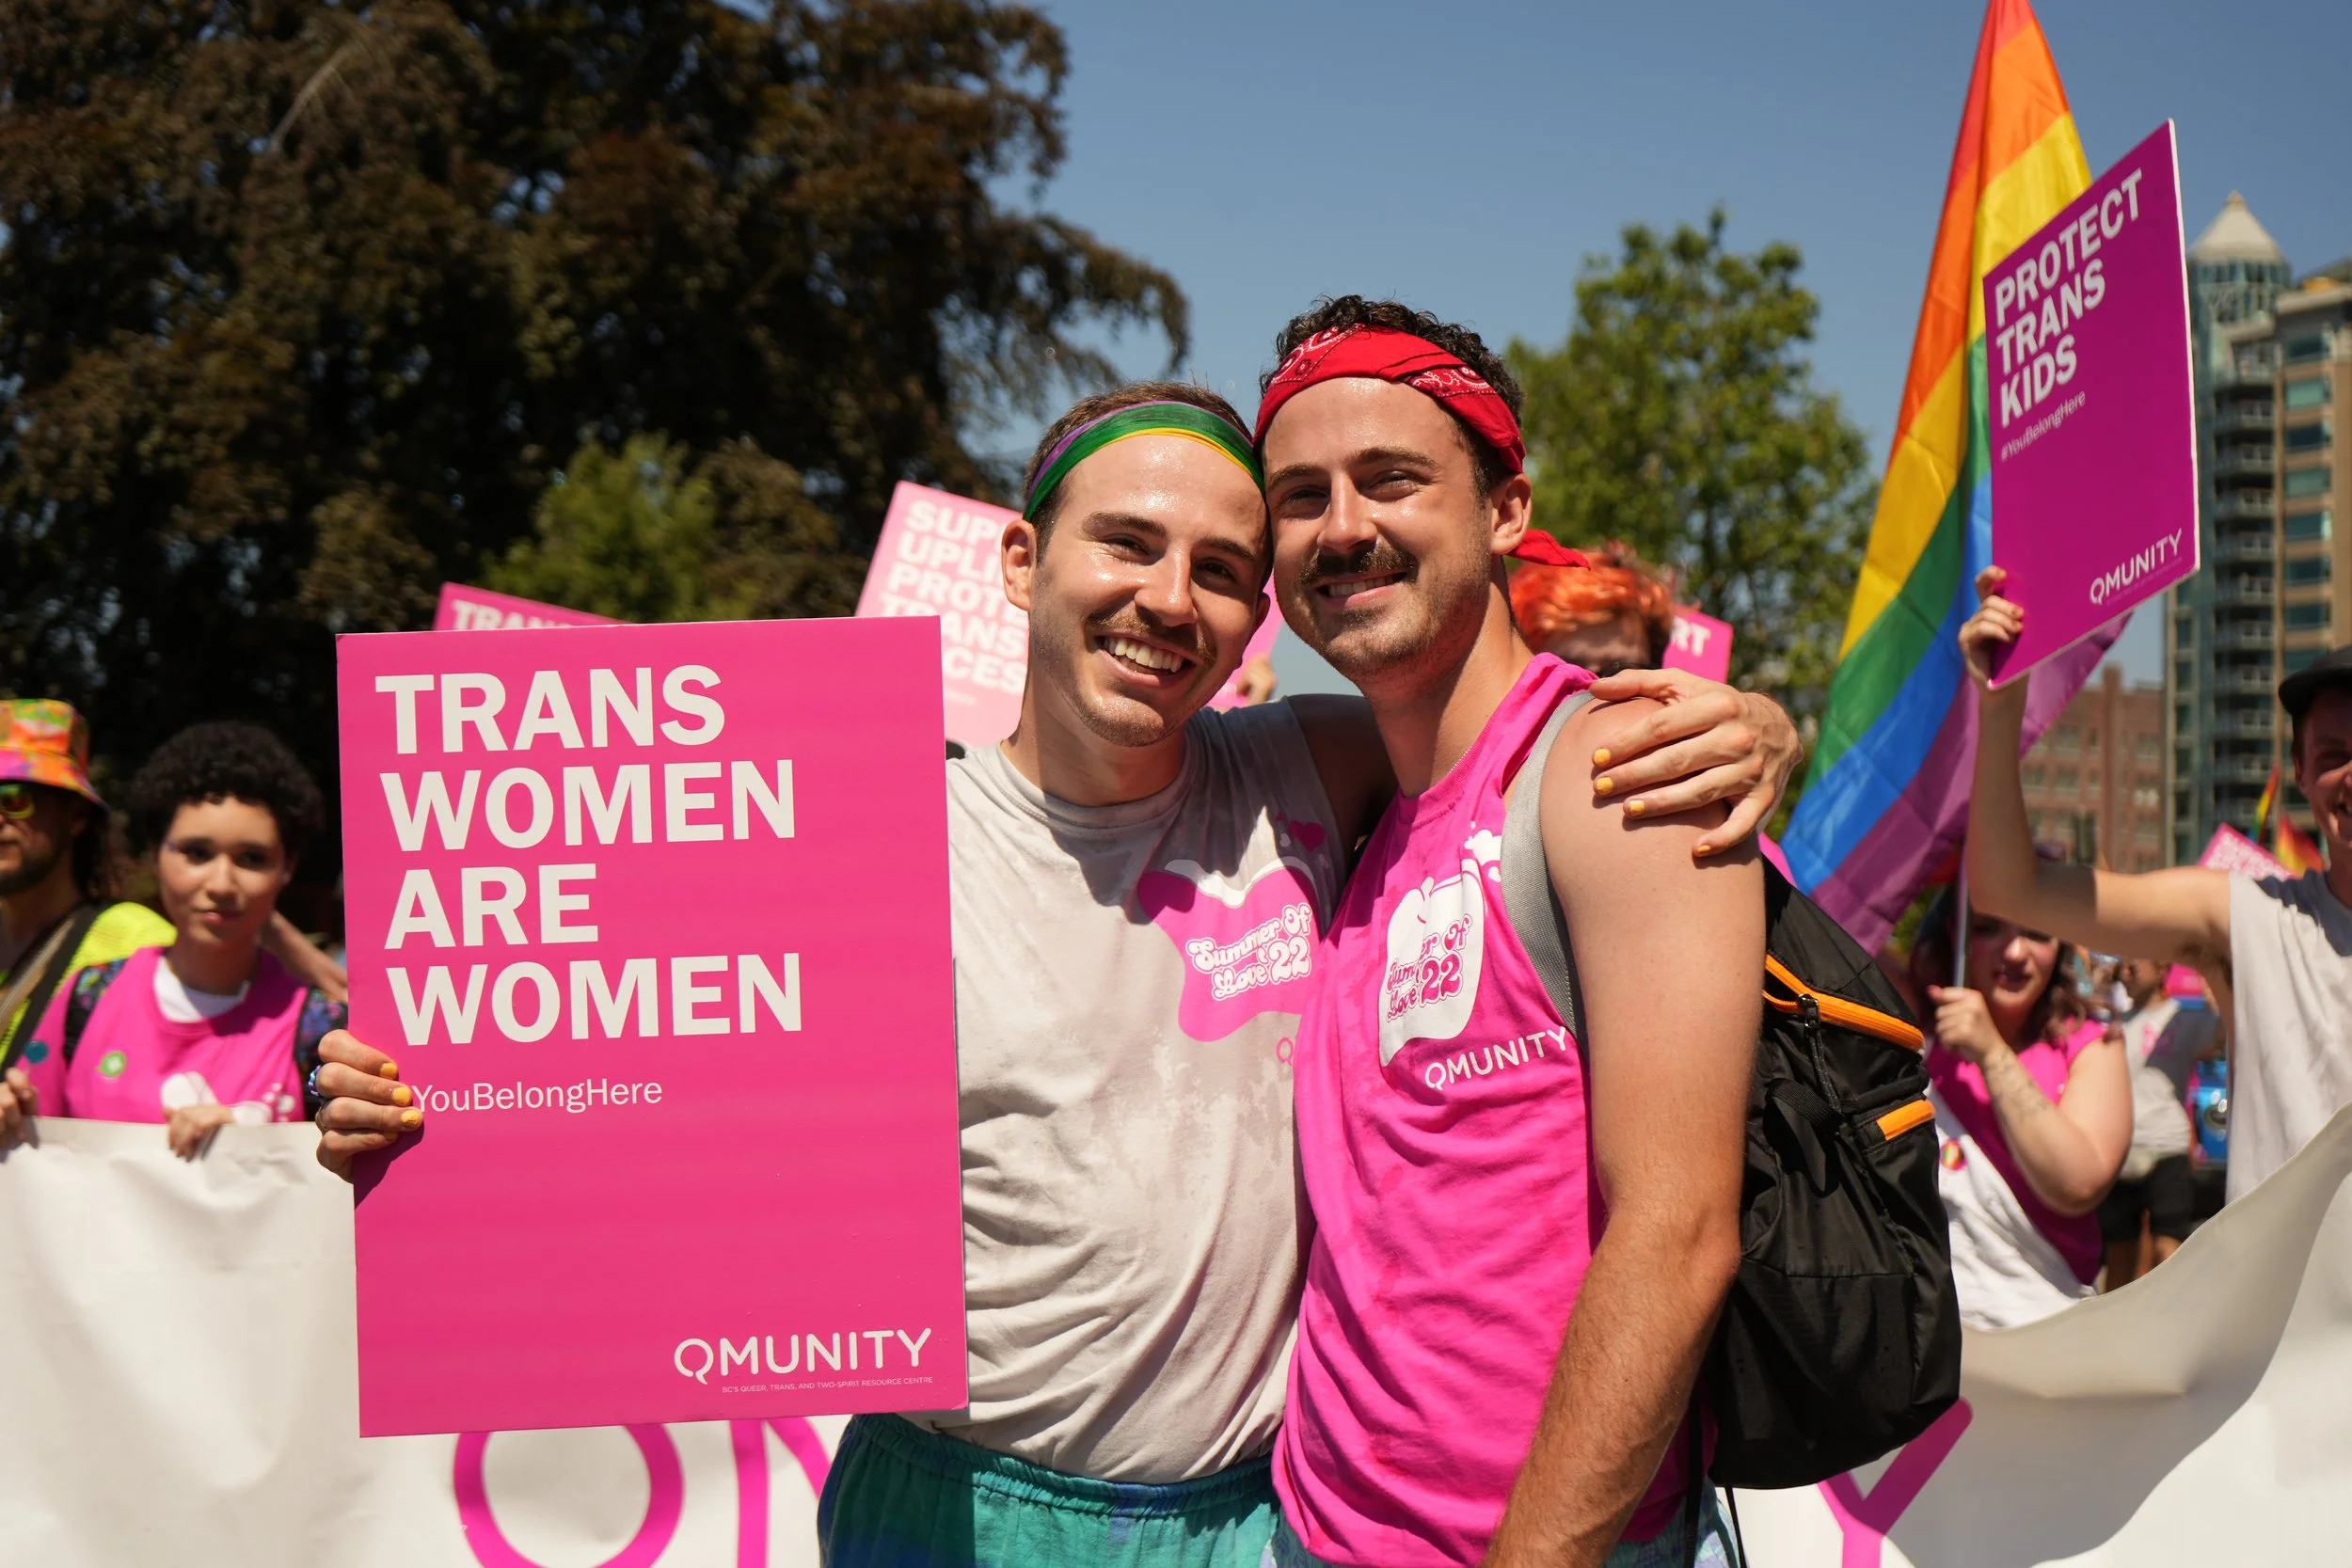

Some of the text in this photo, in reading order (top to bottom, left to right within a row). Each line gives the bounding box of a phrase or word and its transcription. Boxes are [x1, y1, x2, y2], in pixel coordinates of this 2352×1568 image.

[1995, 166, 2142, 328] PROTECT
[1996, 258, 2106, 375] TRANS
[2001, 334, 2077, 429] KIDS
[2001, 390, 2086, 462] #YouBelongHere
[2090, 527, 2183, 606] QMUNITY
[375, 665, 725, 753] TRANS
[380, 759, 795, 852] WOMEN
[385, 863, 598, 950] ARE
[1185, 902, 1312, 974] Summer Of
[386, 953, 802, 1046] WOMEN
[1212, 963, 1269, 1001] Love
[411, 1078, 662, 1114] YouBelongHere
[1424, 1026, 1566, 1090] QMUNITY
[674, 1327, 932, 1385] QMUNITY
[771, 1383, 797, 1391] TRANS,
[817, 1380, 860, 1388] TWO-SPIRIT
[862, 1378, 902, 1386] RESOURCE
[903, 1376, 933, 1385] CENTRE
